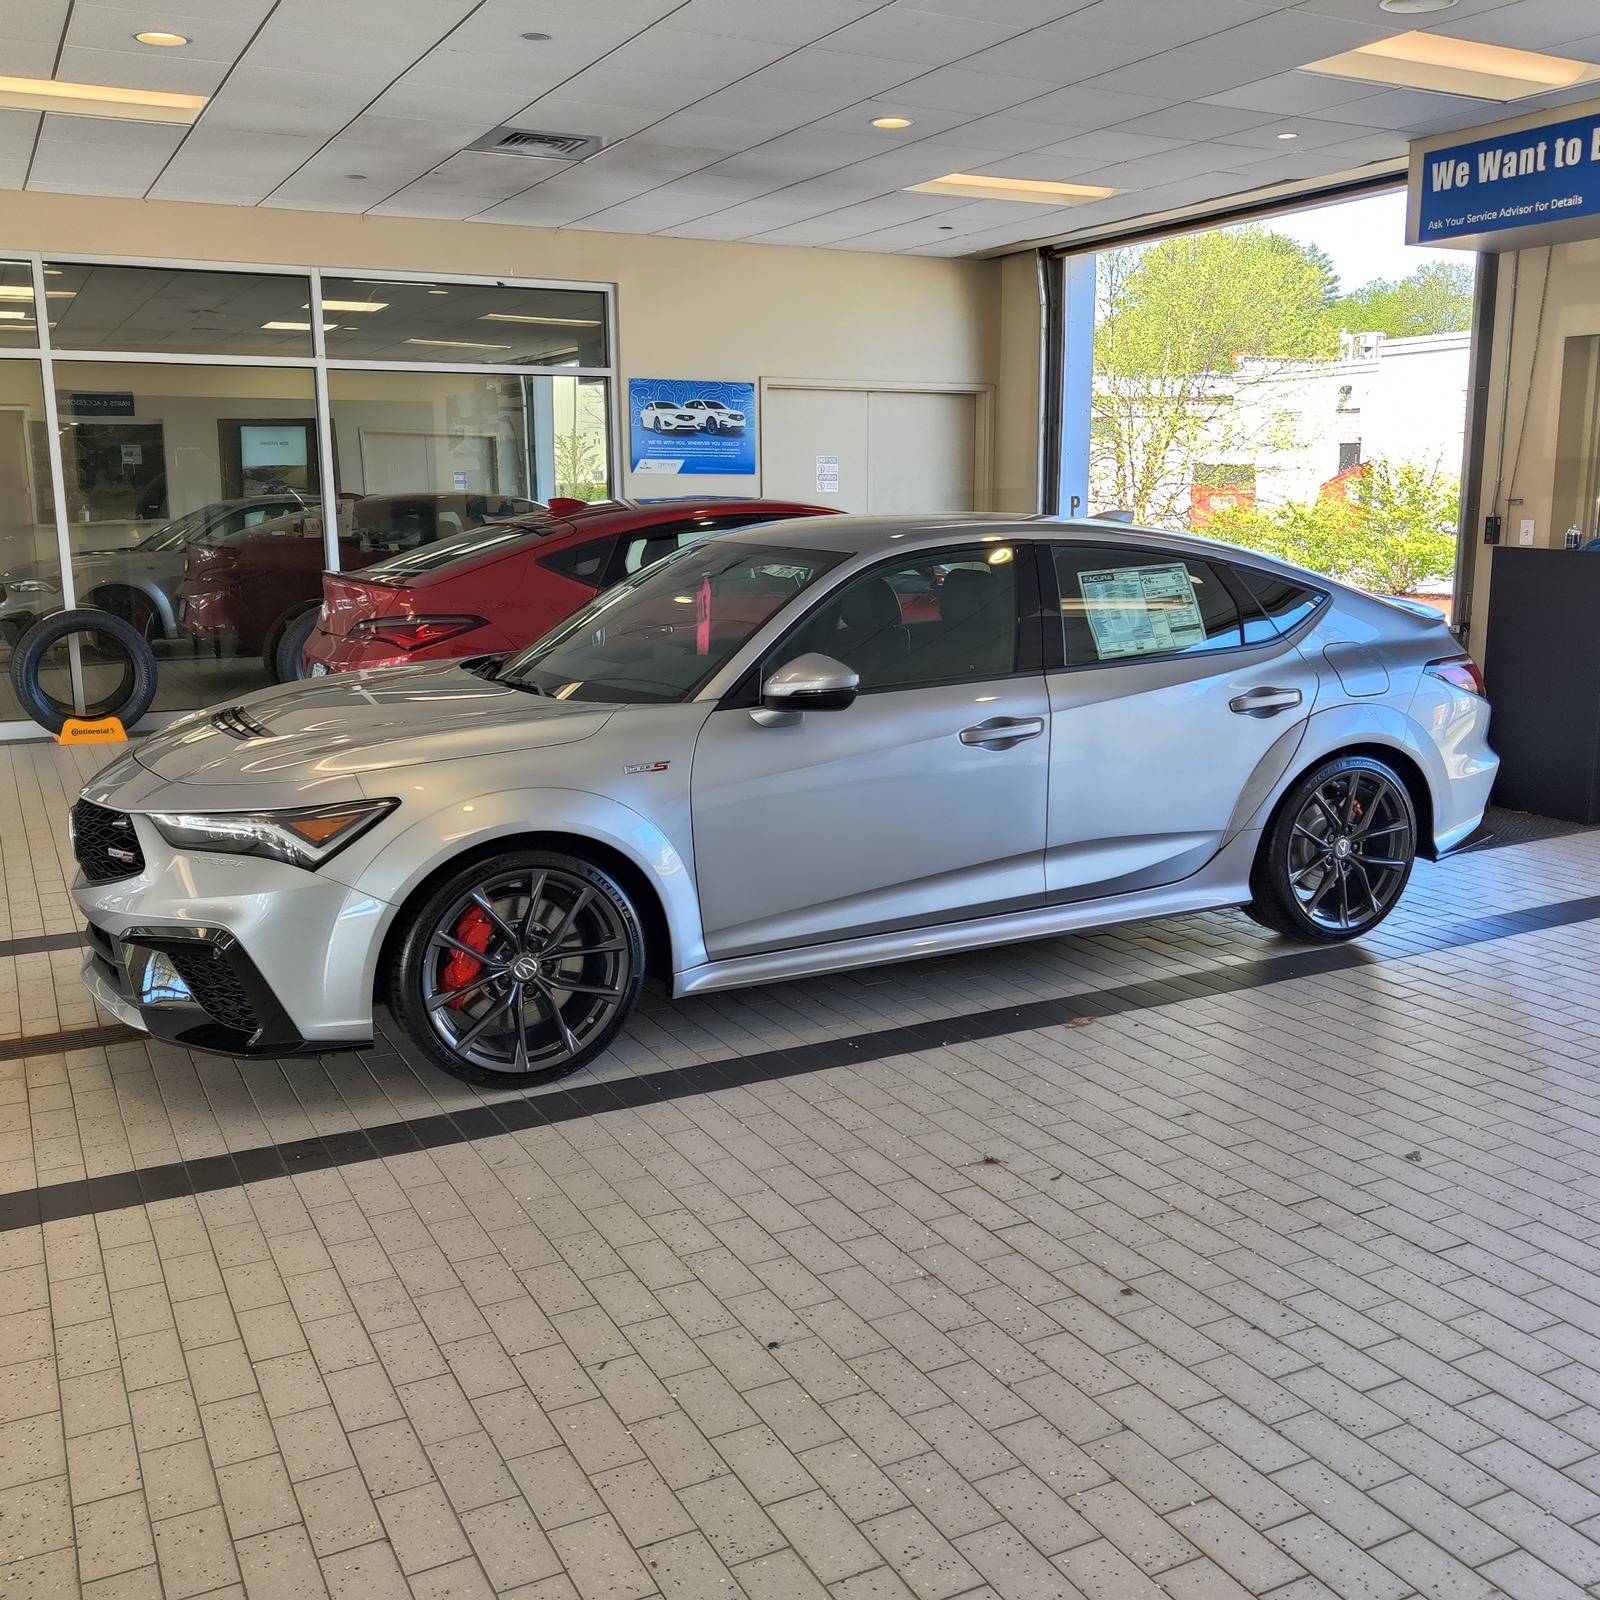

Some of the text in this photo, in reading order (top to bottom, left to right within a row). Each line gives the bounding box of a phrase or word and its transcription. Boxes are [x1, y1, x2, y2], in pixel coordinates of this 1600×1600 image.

[1432, 159, 1470, 192] We
[1478, 142, 1547, 184] Want
[1554, 136, 1582, 168] to
[1428, 195, 1583, 231] Ask Your Service Advisor for Details
[1088, 574, 1113, 582] ACURA
[71, 727, 109, 736] Continental
